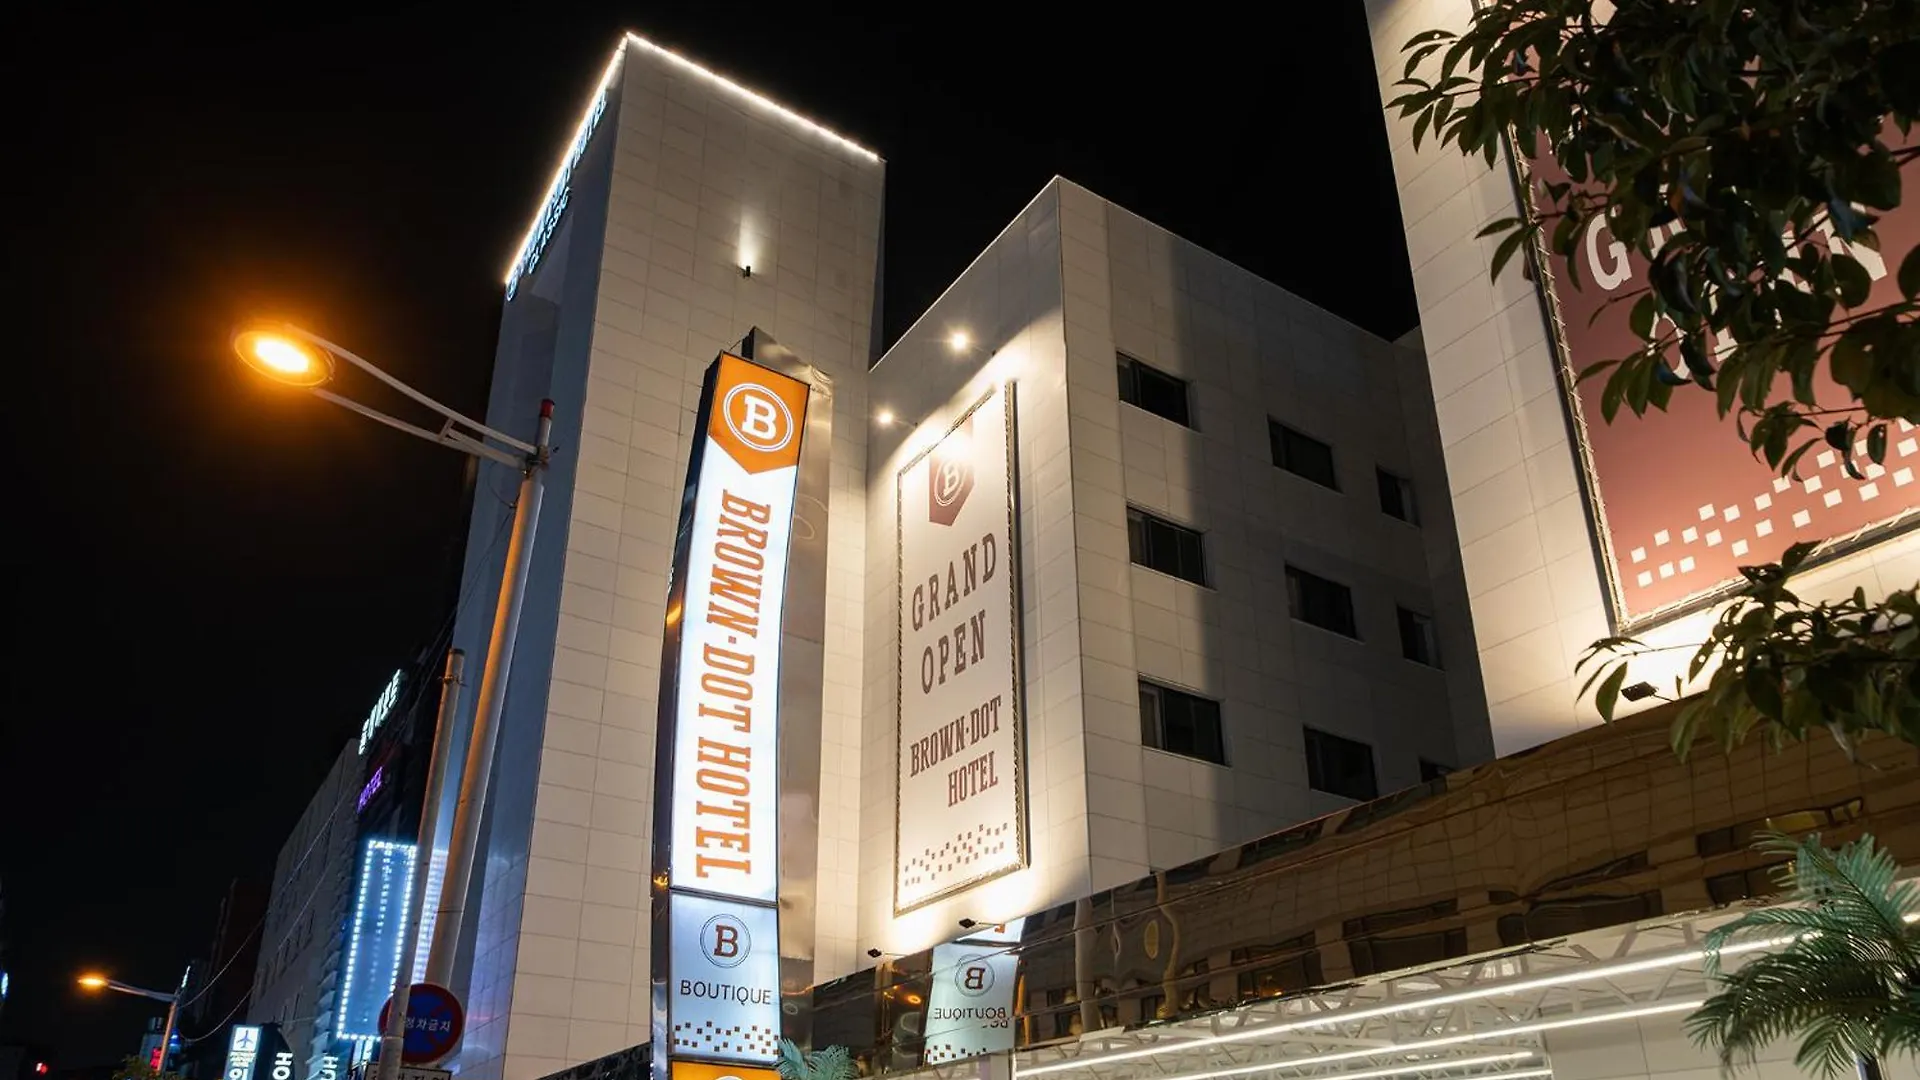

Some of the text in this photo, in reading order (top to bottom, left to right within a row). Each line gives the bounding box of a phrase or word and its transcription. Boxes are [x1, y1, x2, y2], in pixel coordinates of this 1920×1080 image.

[741, 393, 777, 440] B
[912, 532, 996, 632] GRAND
[921, 608, 986, 694] OPEN
[695, 736, 752, 879] HOTEL
[948, 750, 998, 808] HOTEL
[714, 925, 739, 958] B
[680, 979, 772, 1006] BOUTIQUE
